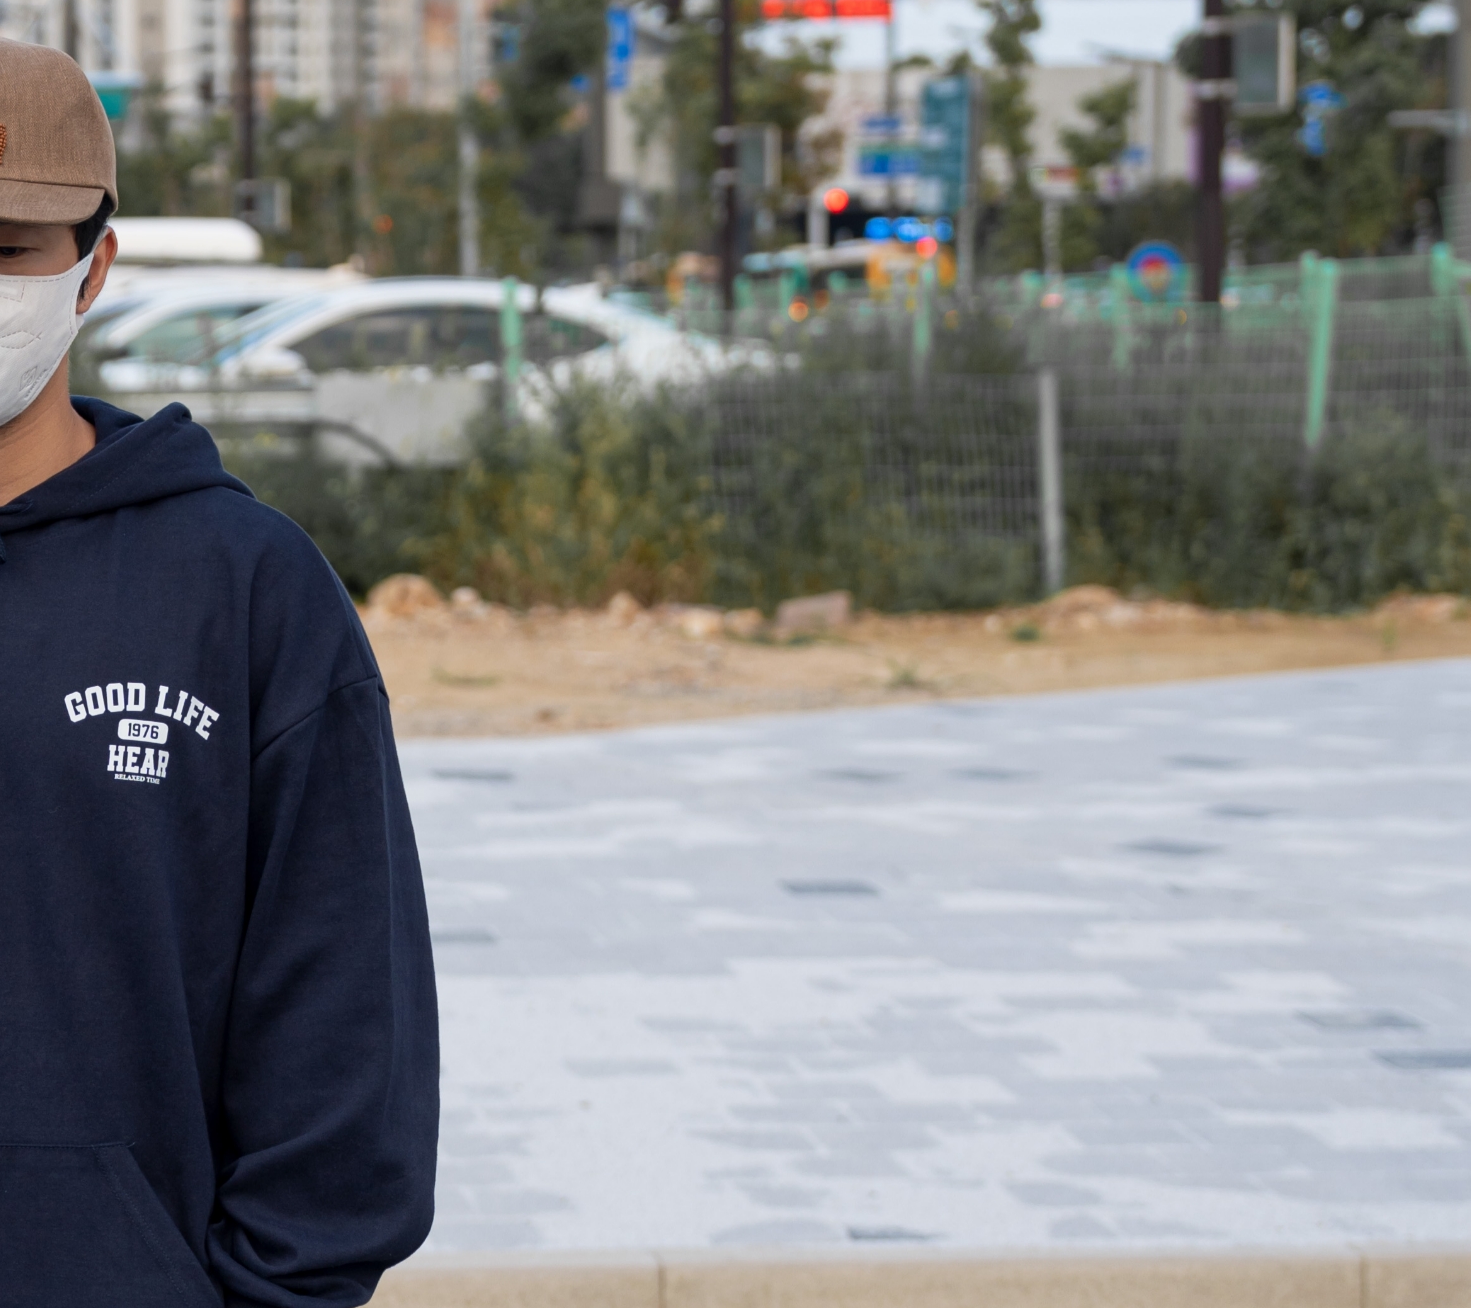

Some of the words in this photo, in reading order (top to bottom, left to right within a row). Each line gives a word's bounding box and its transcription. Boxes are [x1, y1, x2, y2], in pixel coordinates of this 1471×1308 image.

[64, 682, 146, 723] GOOD
[154, 685, 220, 740] LIFE
[127, 722, 160, 740] 1976
[106, 744, 170, 778] HEAR
[114, 773, 145, 782] RELAXED
